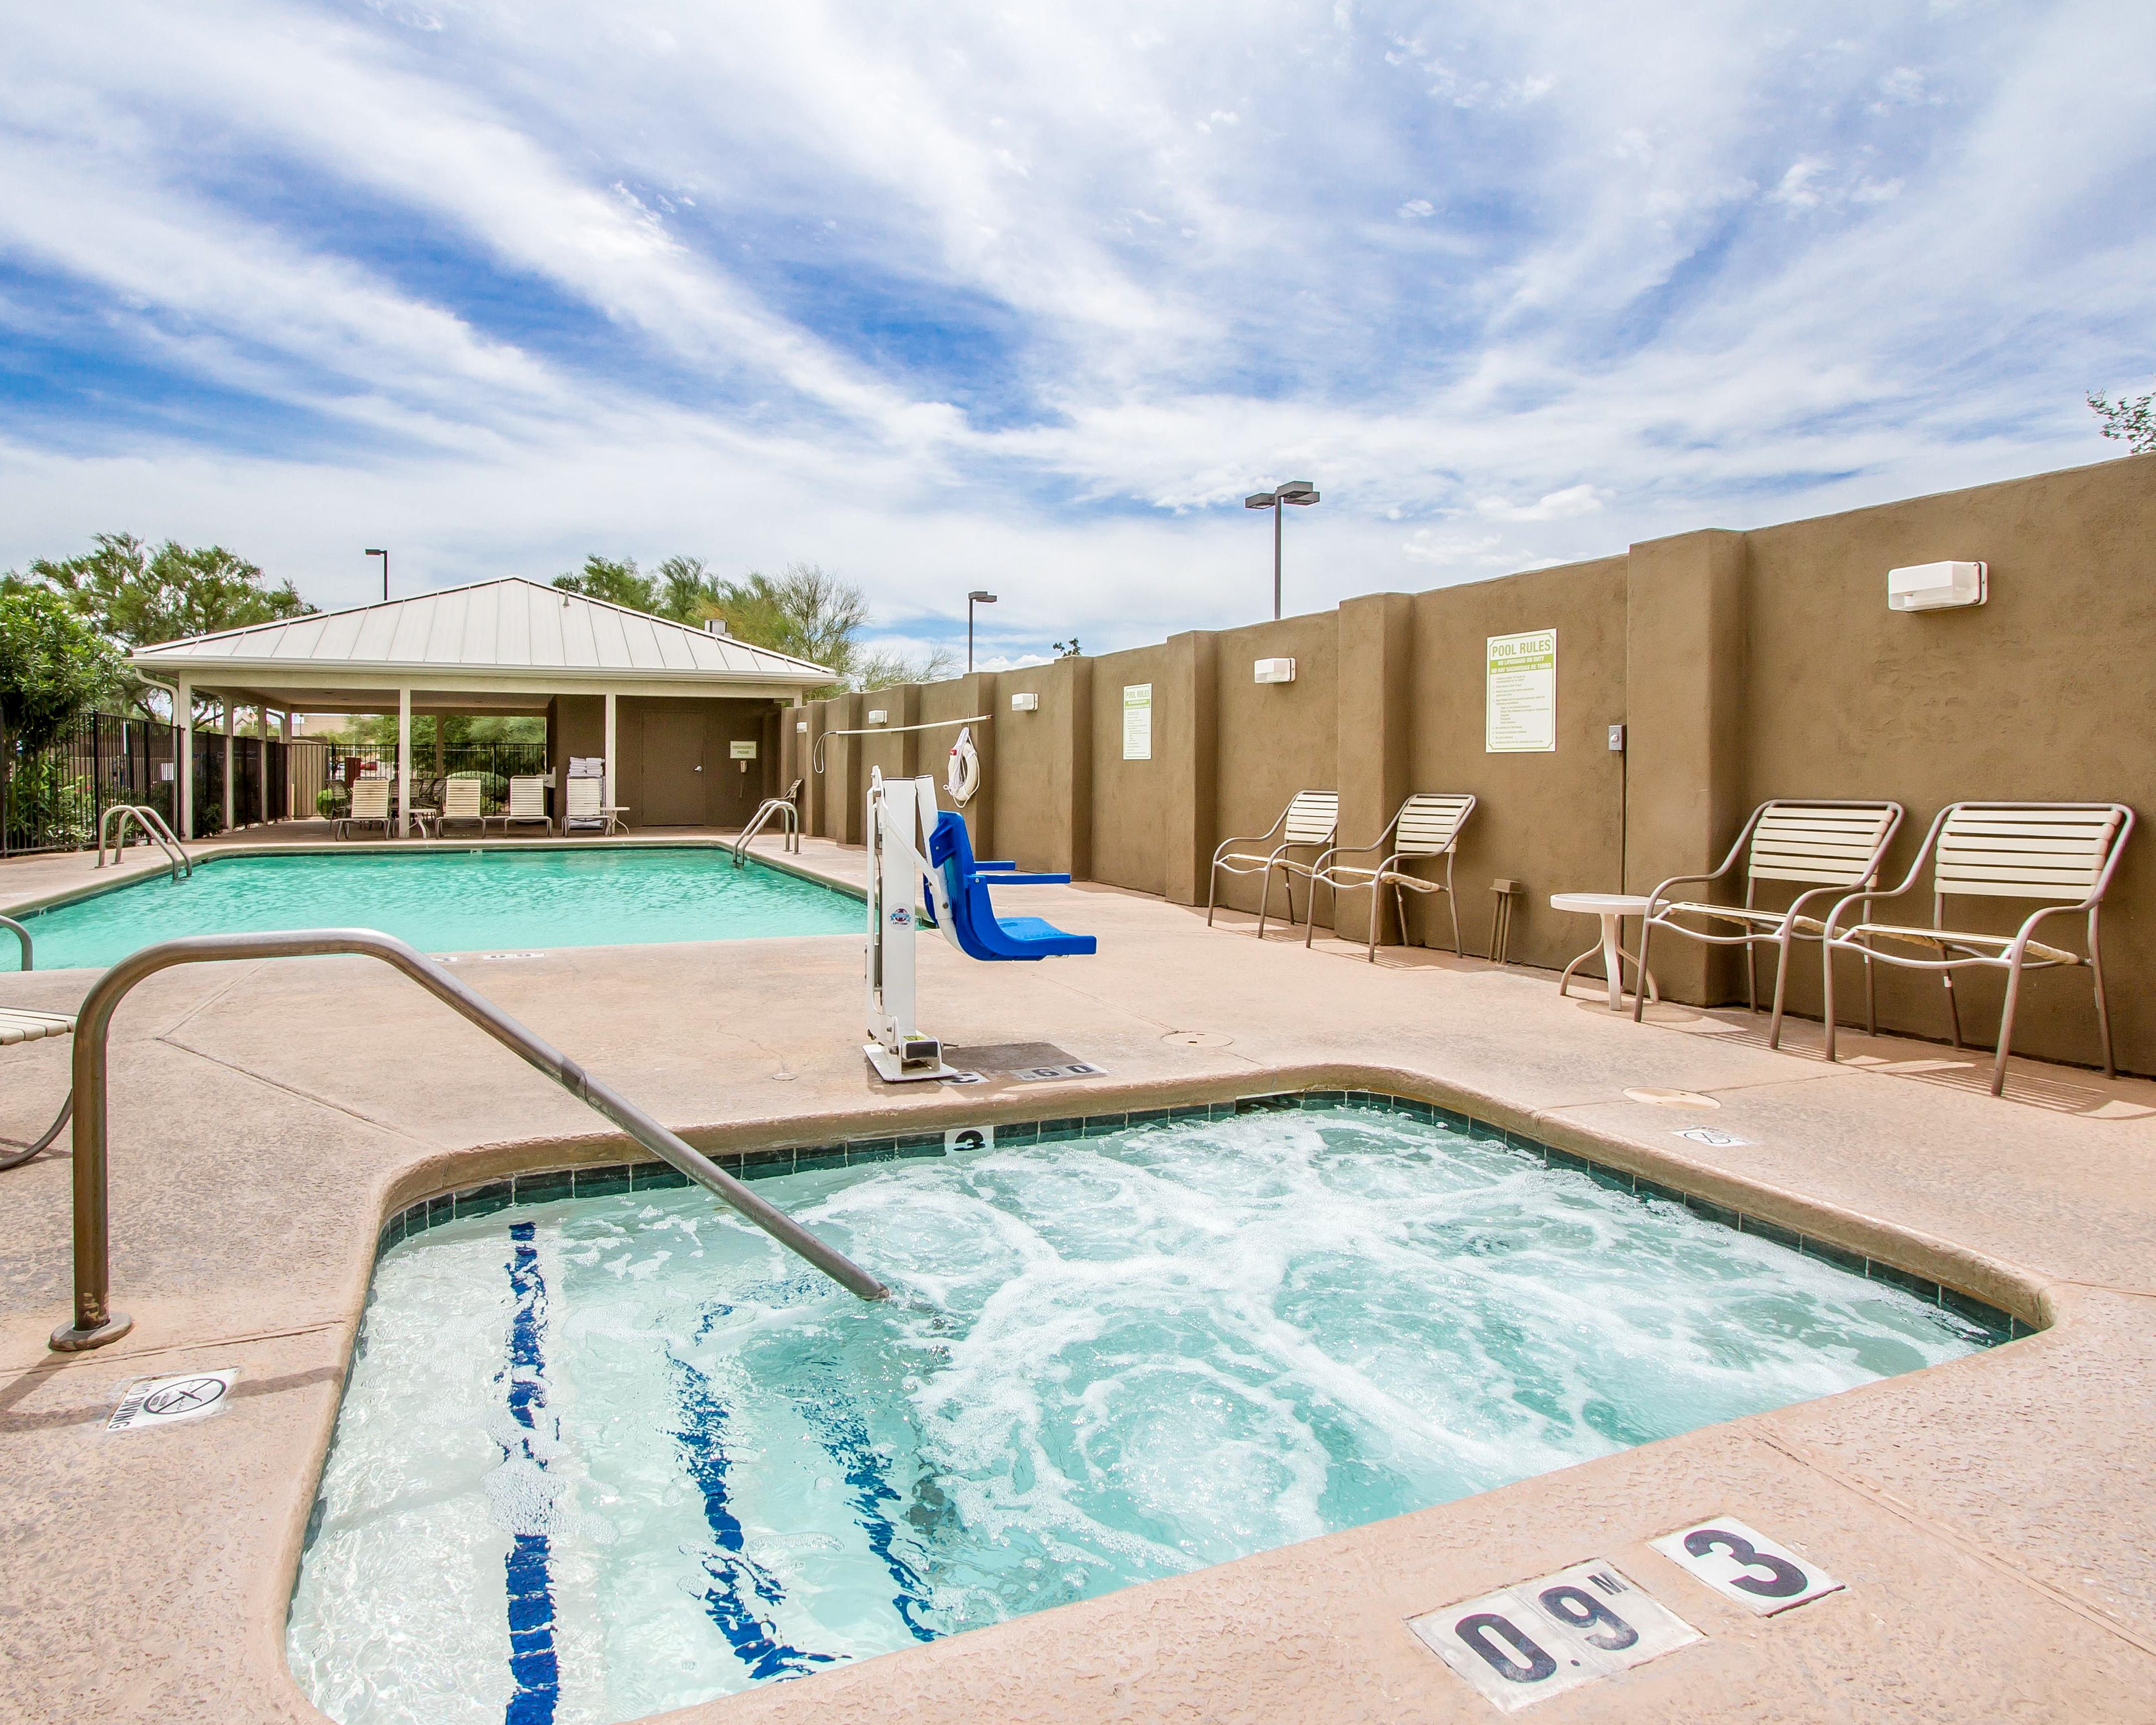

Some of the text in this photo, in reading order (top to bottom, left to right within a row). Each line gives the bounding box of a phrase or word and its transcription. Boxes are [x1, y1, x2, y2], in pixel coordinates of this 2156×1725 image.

[1492, 639, 1551, 657] POOL RULES
[108, 1397, 145, 1429] DIVING
[1684, 1530, 1808, 1598] 3
